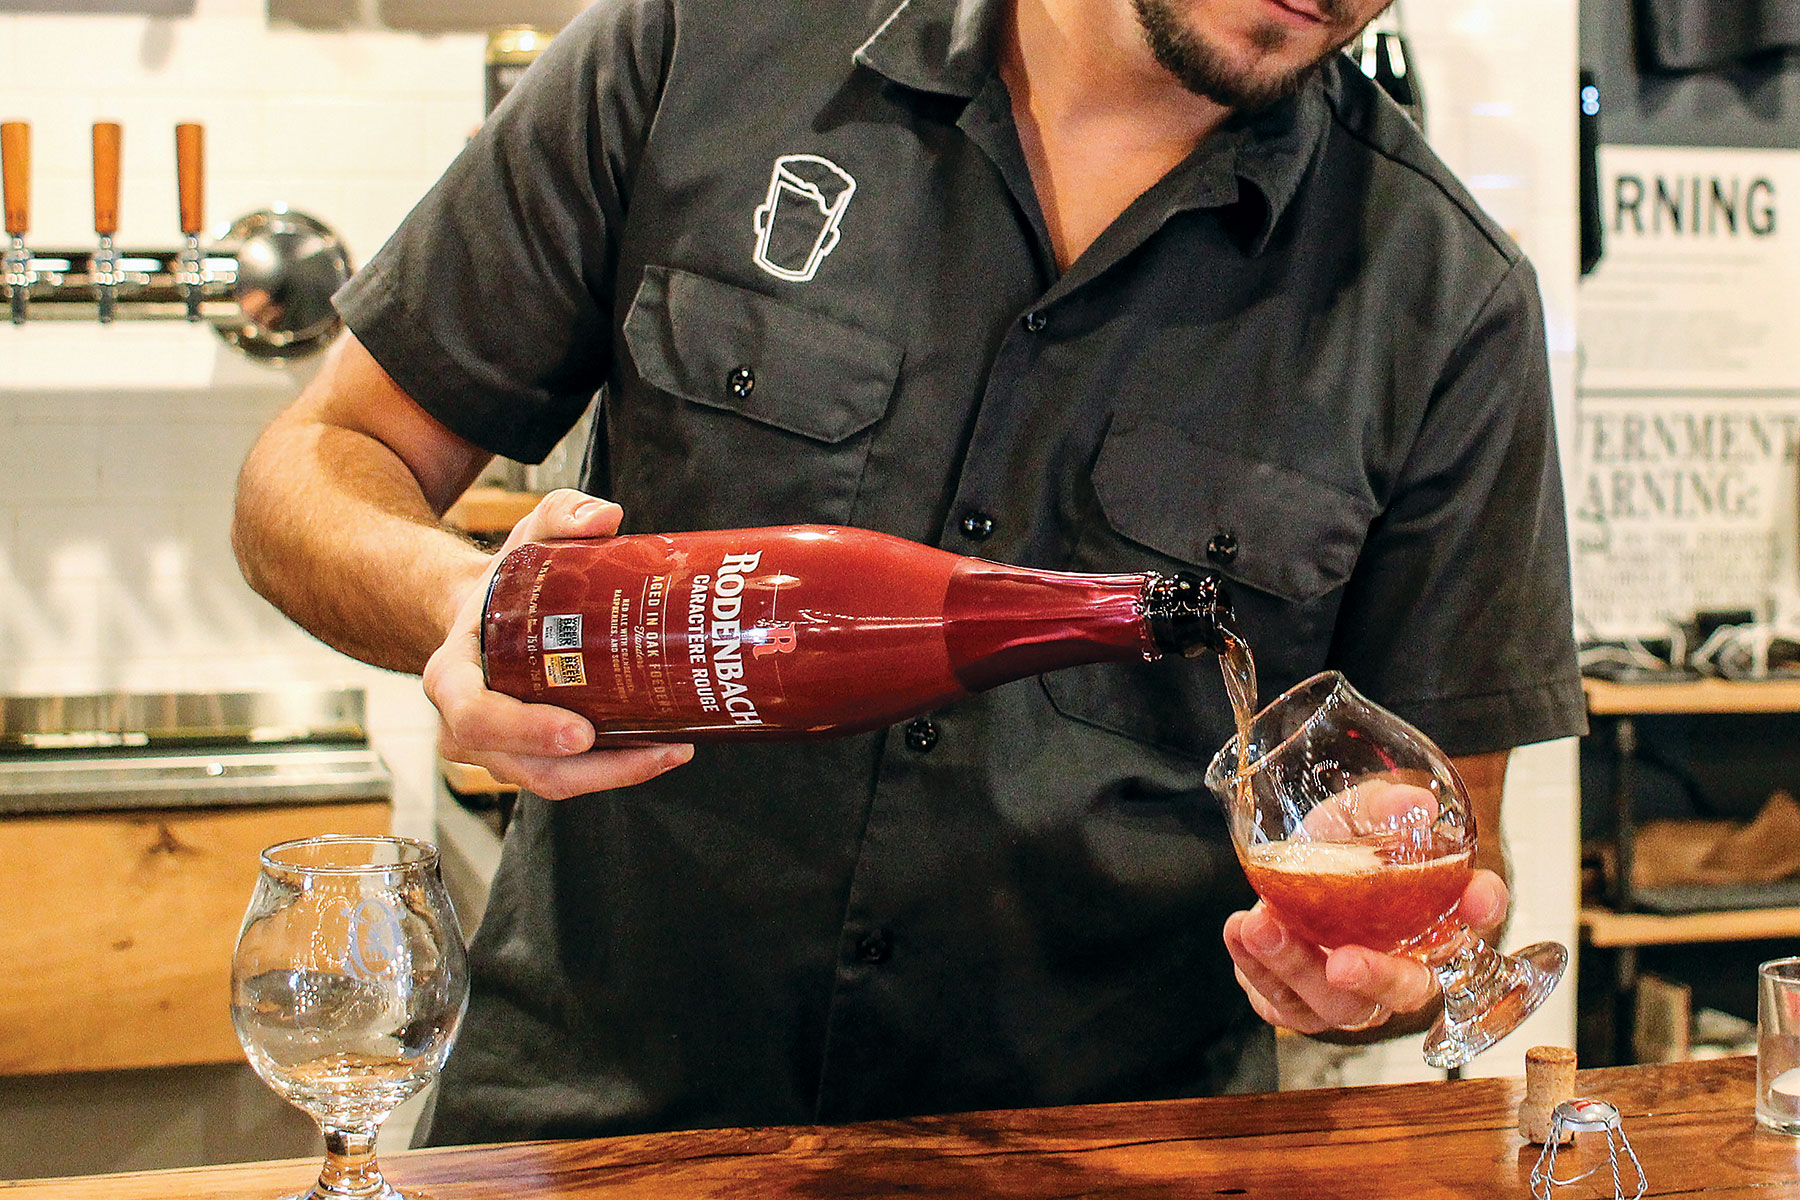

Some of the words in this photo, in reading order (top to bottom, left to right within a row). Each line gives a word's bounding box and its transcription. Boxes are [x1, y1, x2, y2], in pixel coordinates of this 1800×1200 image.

[1614, 175, 1777, 236] RNING
[647, 575, 665, 606] AGED
[621, 598, 630, 612] RED
[646, 611, 659, 626] IN
[563, 618, 573, 646] BEER
[620, 613, 629, 626] ALE
[687, 574, 711, 664] CARACTÈRE
[610, 638, 619, 653] AND
[620, 627, 628, 646] WITH
[646, 631, 659, 658] OAK
[711, 550, 763, 725] RODENBACH
[564, 656, 576, 683] BEER
[648, 663, 673, 714] FOEDERS
[691, 667, 720, 713] ROUGE
